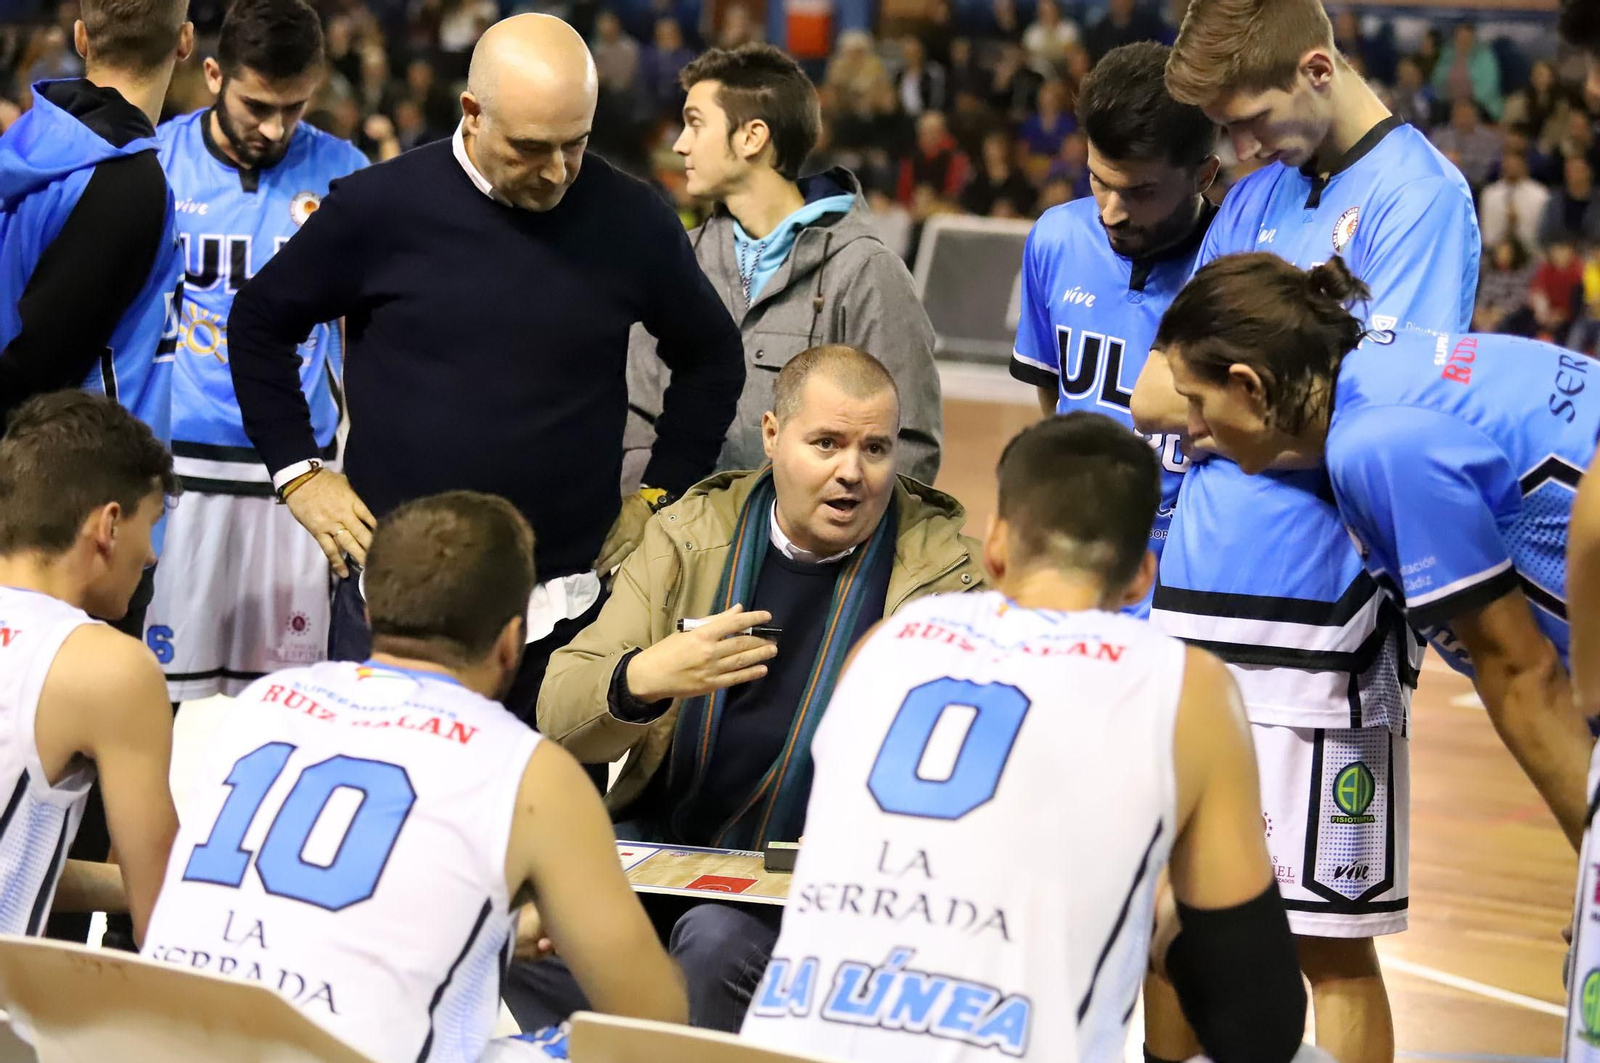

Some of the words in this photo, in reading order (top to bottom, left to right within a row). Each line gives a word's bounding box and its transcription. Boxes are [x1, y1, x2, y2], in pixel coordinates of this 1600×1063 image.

[261, 684, 338, 724] RUIZ
[866, 675, 1033, 821] 0
[181, 741, 418, 912] 10
[877, 839, 935, 880] LA
[222, 909, 269, 951] LA
[752, 957, 821, 1018] LA
[820, 945, 1033, 1059] LÍNEA
